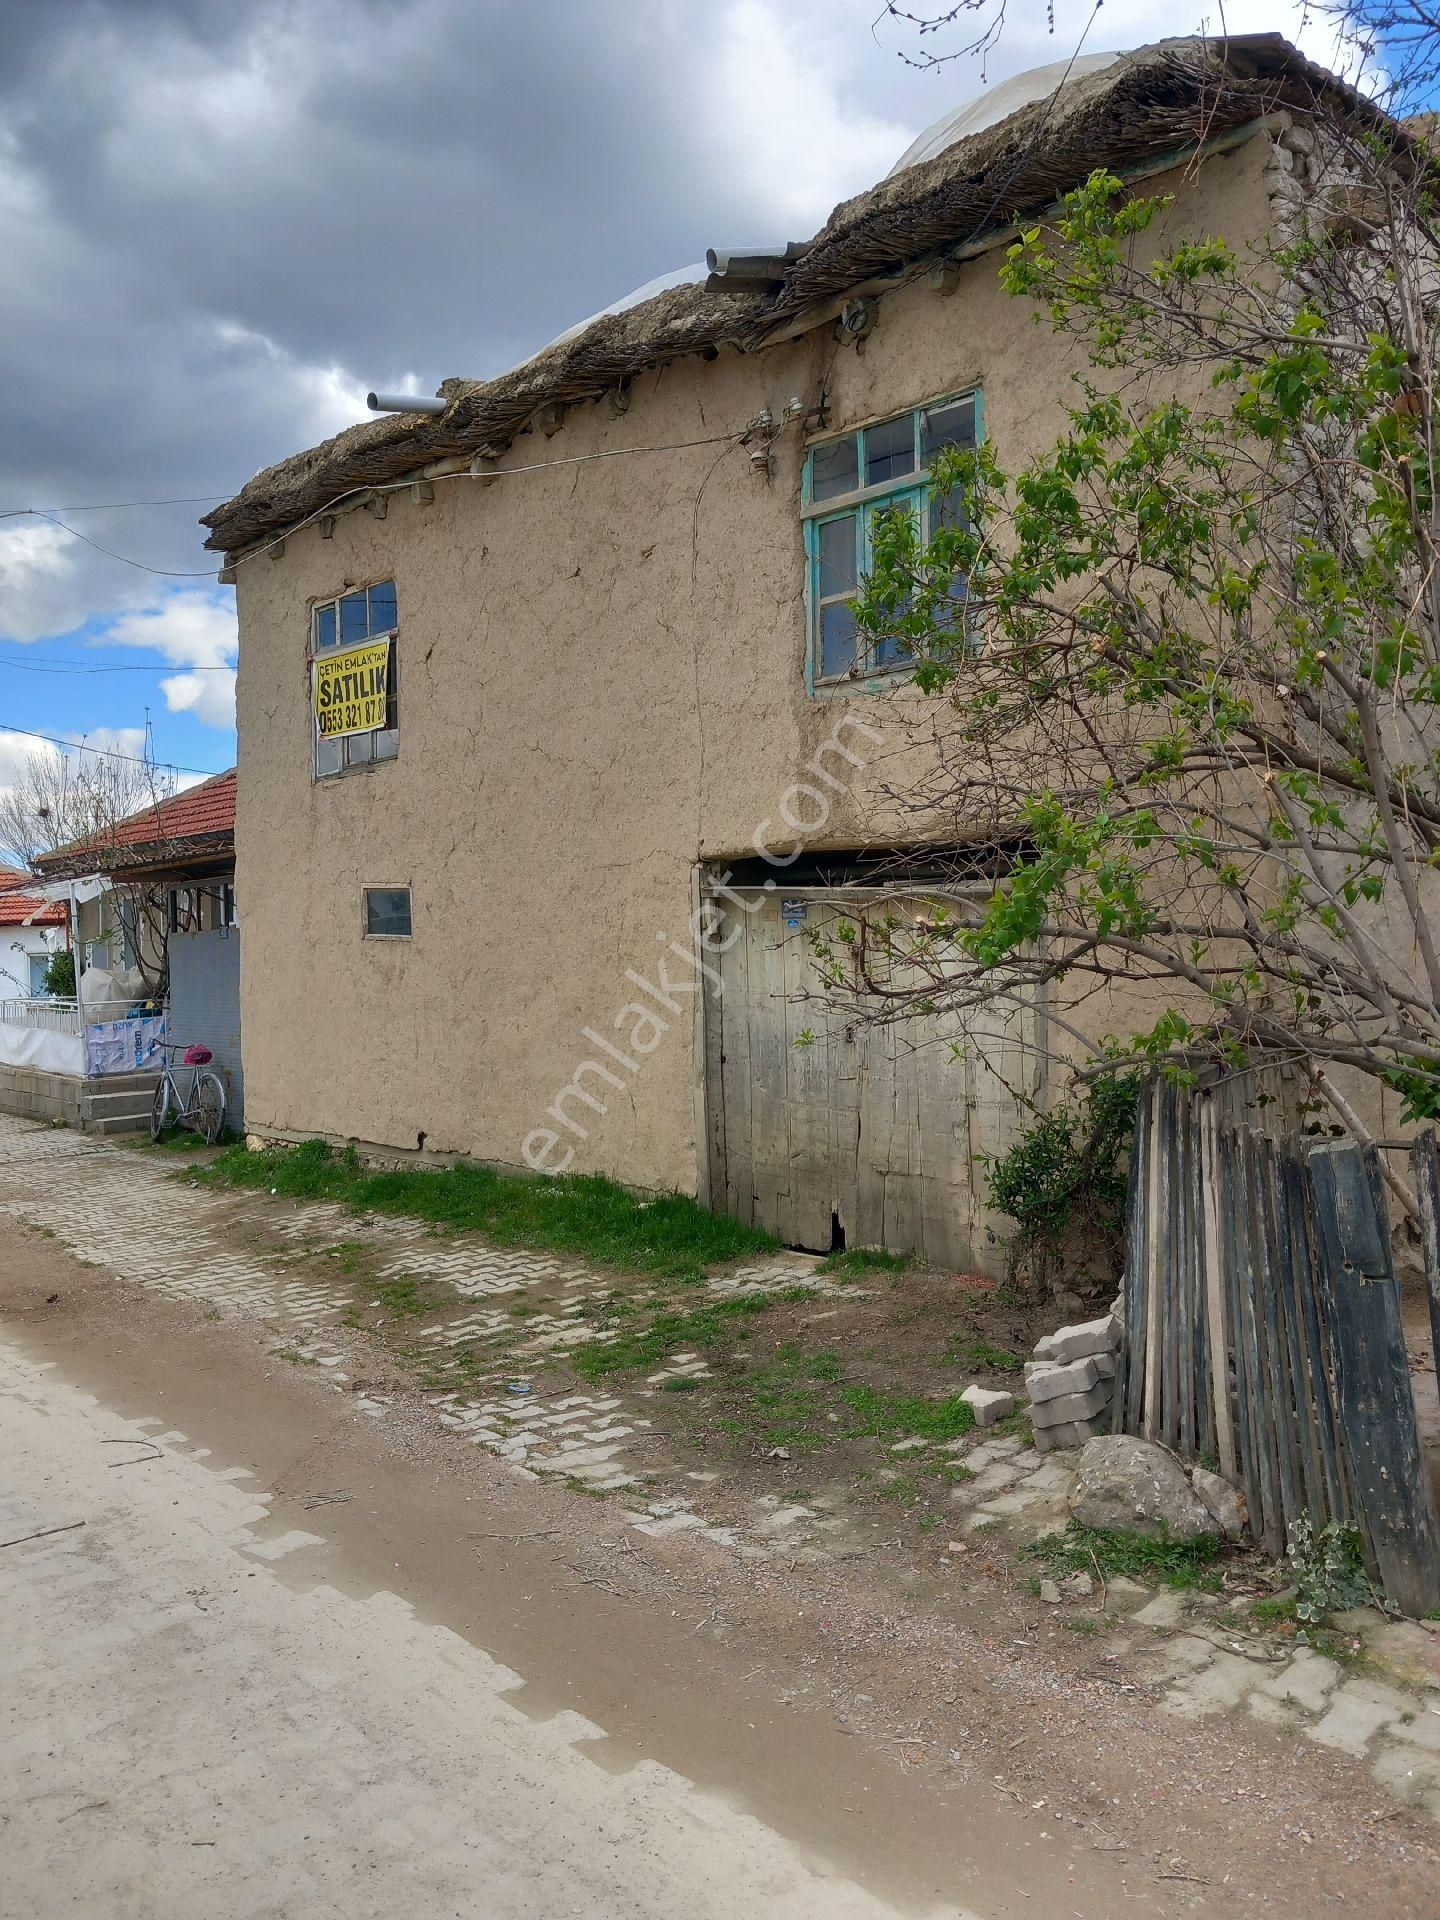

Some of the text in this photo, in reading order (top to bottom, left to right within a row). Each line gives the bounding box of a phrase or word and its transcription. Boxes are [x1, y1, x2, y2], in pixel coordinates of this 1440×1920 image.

[319, 651, 386, 678] ÇETİN EMLAK'TAN
[320, 664, 386, 707] SATILIK
[319, 708, 342, 733] 0553
[345, 705, 361, 728] 321
[365, 699, 376, 724] 87
